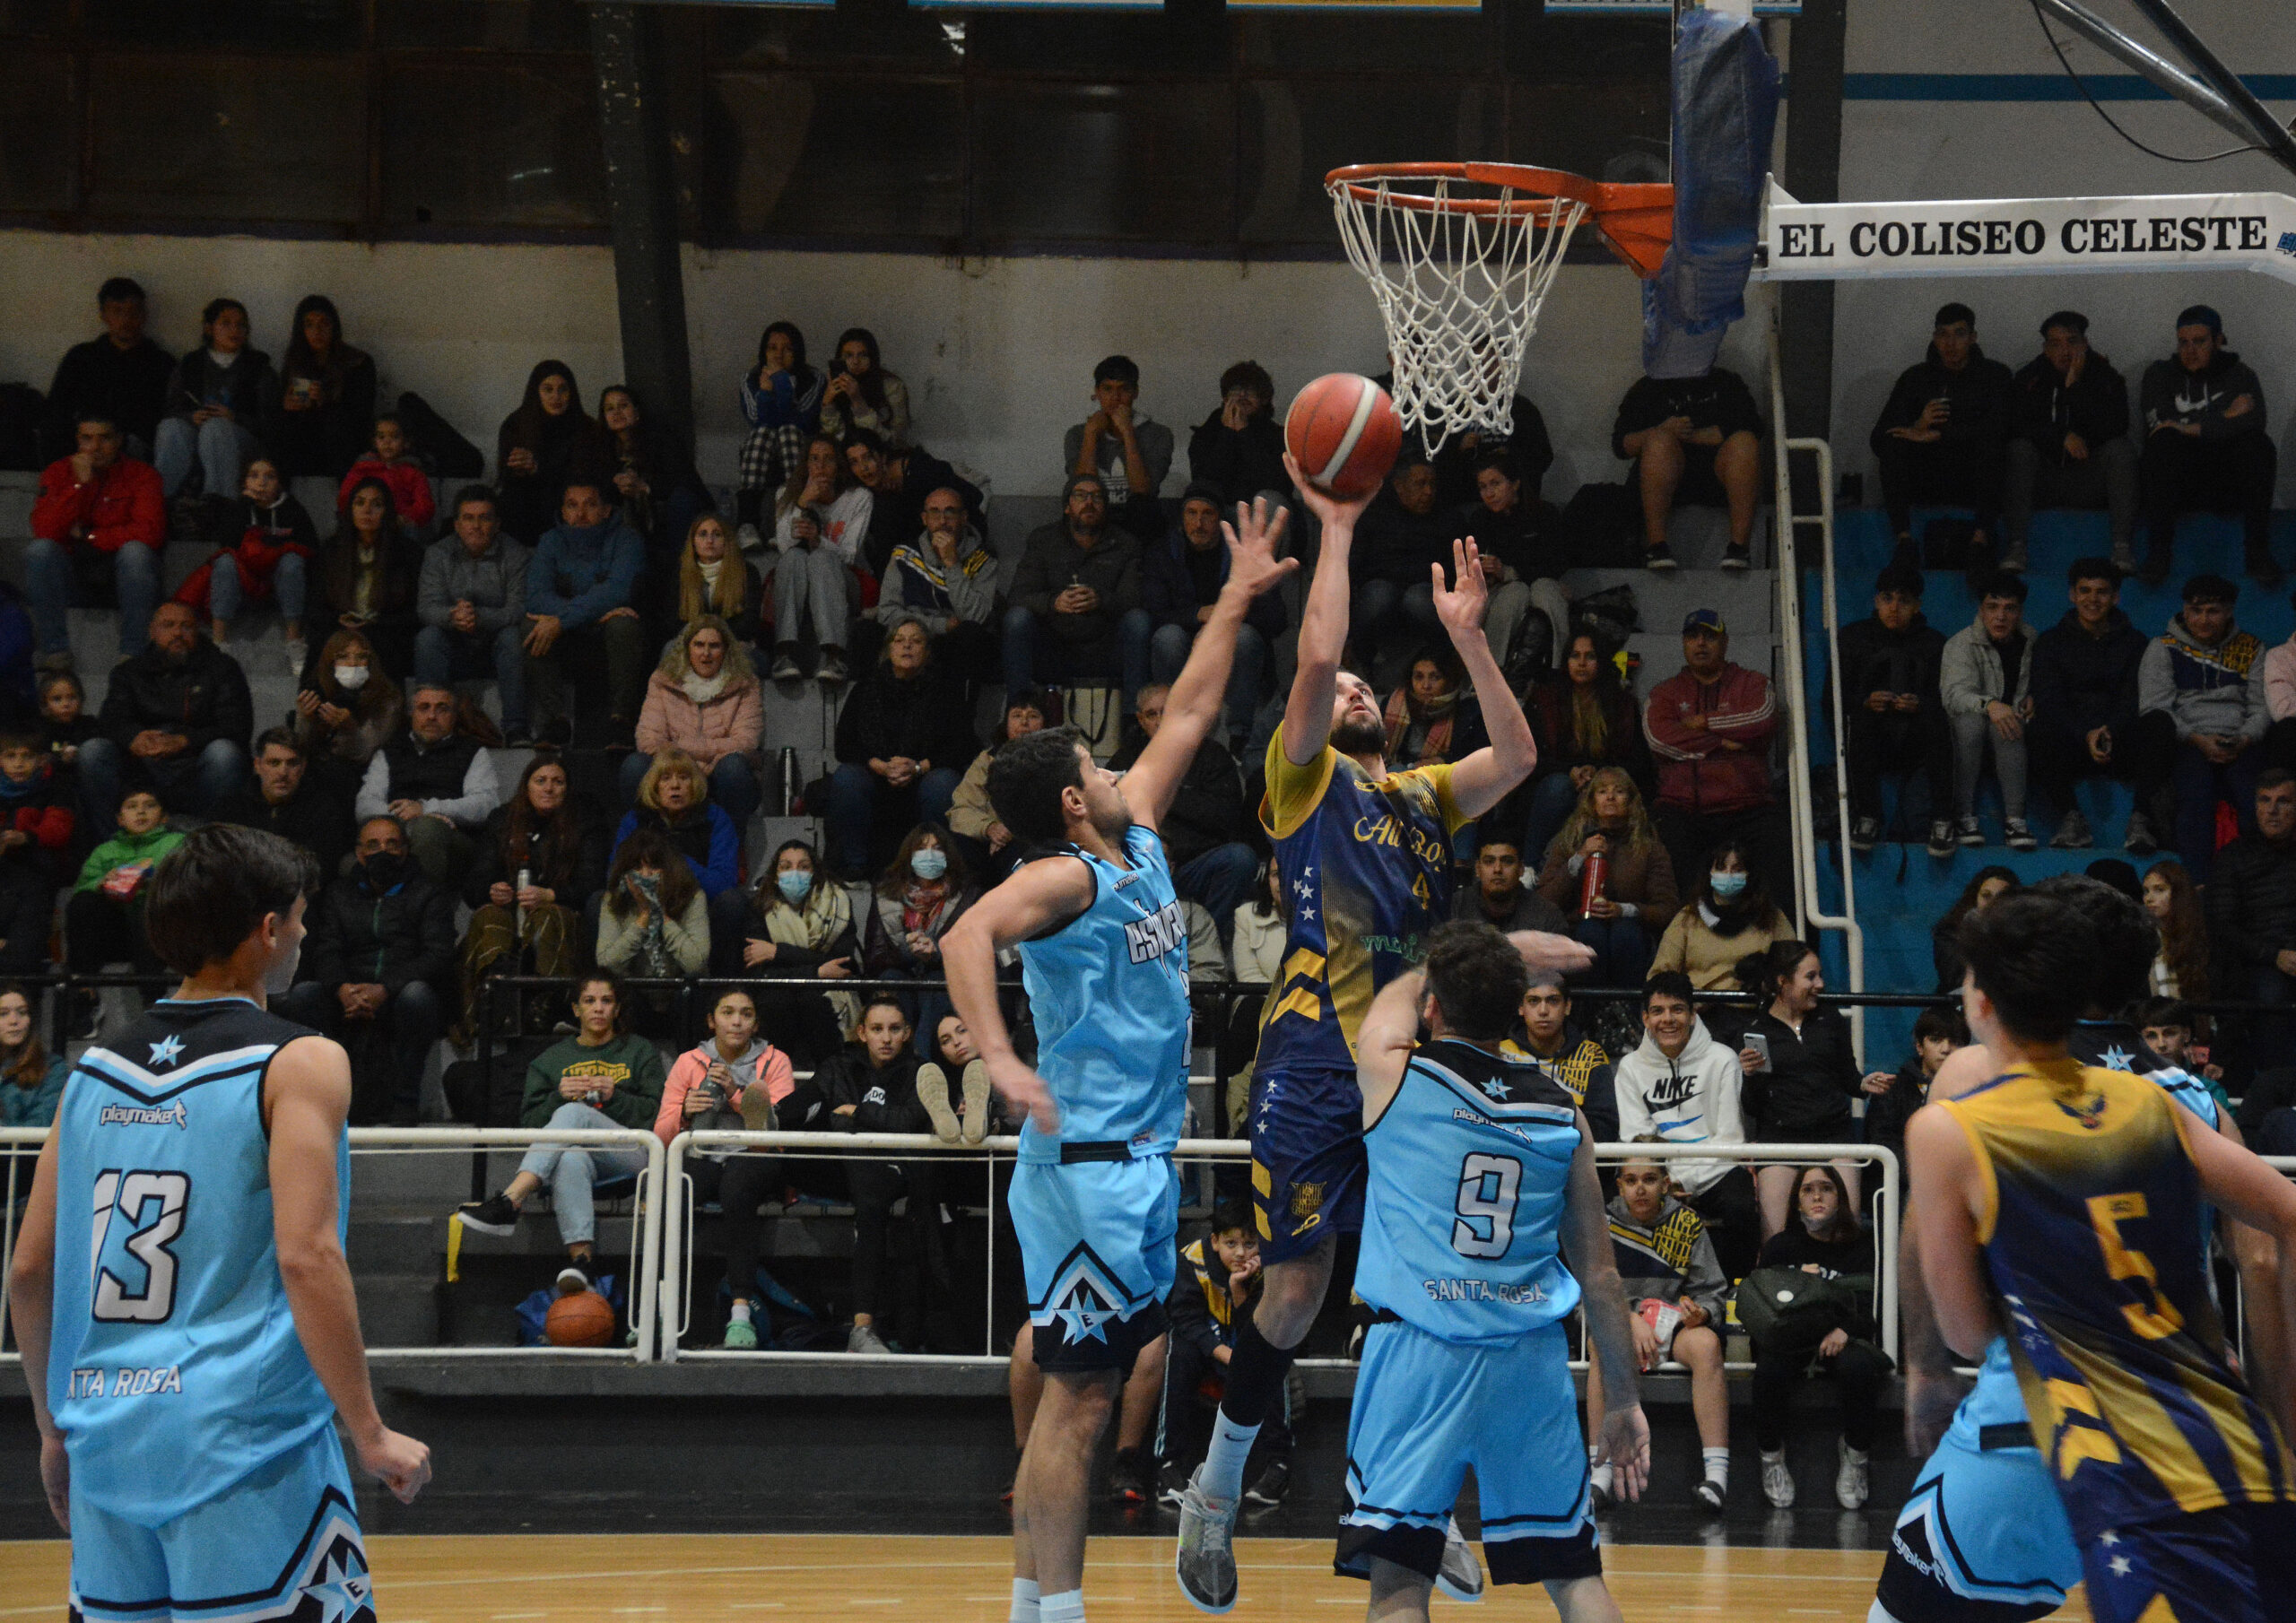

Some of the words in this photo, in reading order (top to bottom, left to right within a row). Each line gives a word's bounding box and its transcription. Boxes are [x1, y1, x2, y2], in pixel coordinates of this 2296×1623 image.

[1779, 224, 1834, 257] EL
[1850, 220, 2046, 257] COLISEO
[2062, 216, 2267, 253] CELESTE
[1413, 872, 1431, 911] 4
[1652, 1075, 1698, 1099] NIKE
[1450, 1151, 1522, 1260] 9
[91, 1168, 191, 1324] 13
[2084, 1191, 2185, 1341] 5
[1423, 1279, 1495, 1301] SANTA
[1498, 1282, 1549, 1304] ROSA
[112, 1364, 182, 1396] ROSA
[345, 1581, 364, 1598] E
